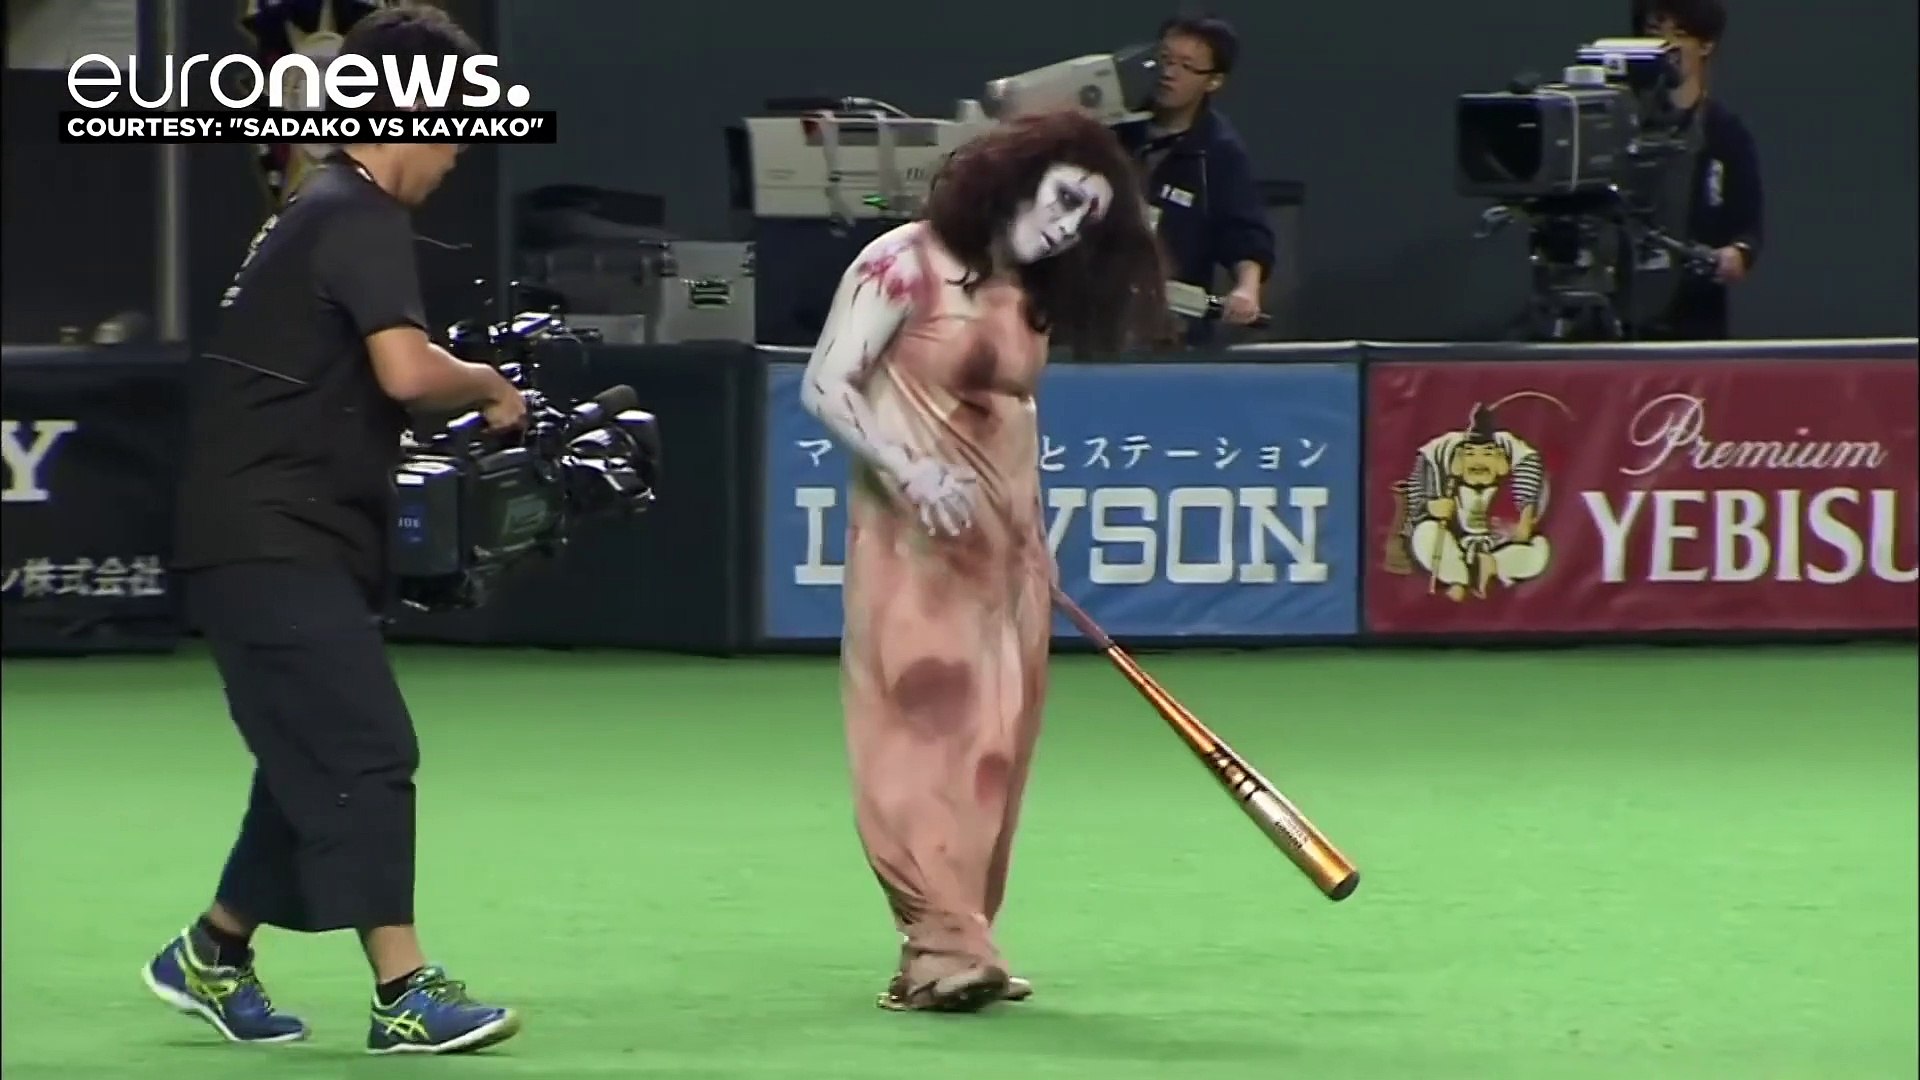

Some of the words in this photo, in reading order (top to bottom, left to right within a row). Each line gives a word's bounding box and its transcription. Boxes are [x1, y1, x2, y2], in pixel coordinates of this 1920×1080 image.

[1618, 393, 1888, 476] Premium
[794, 487, 1328, 584] LSON
[1580, 487, 1918, 584] YEBISU
